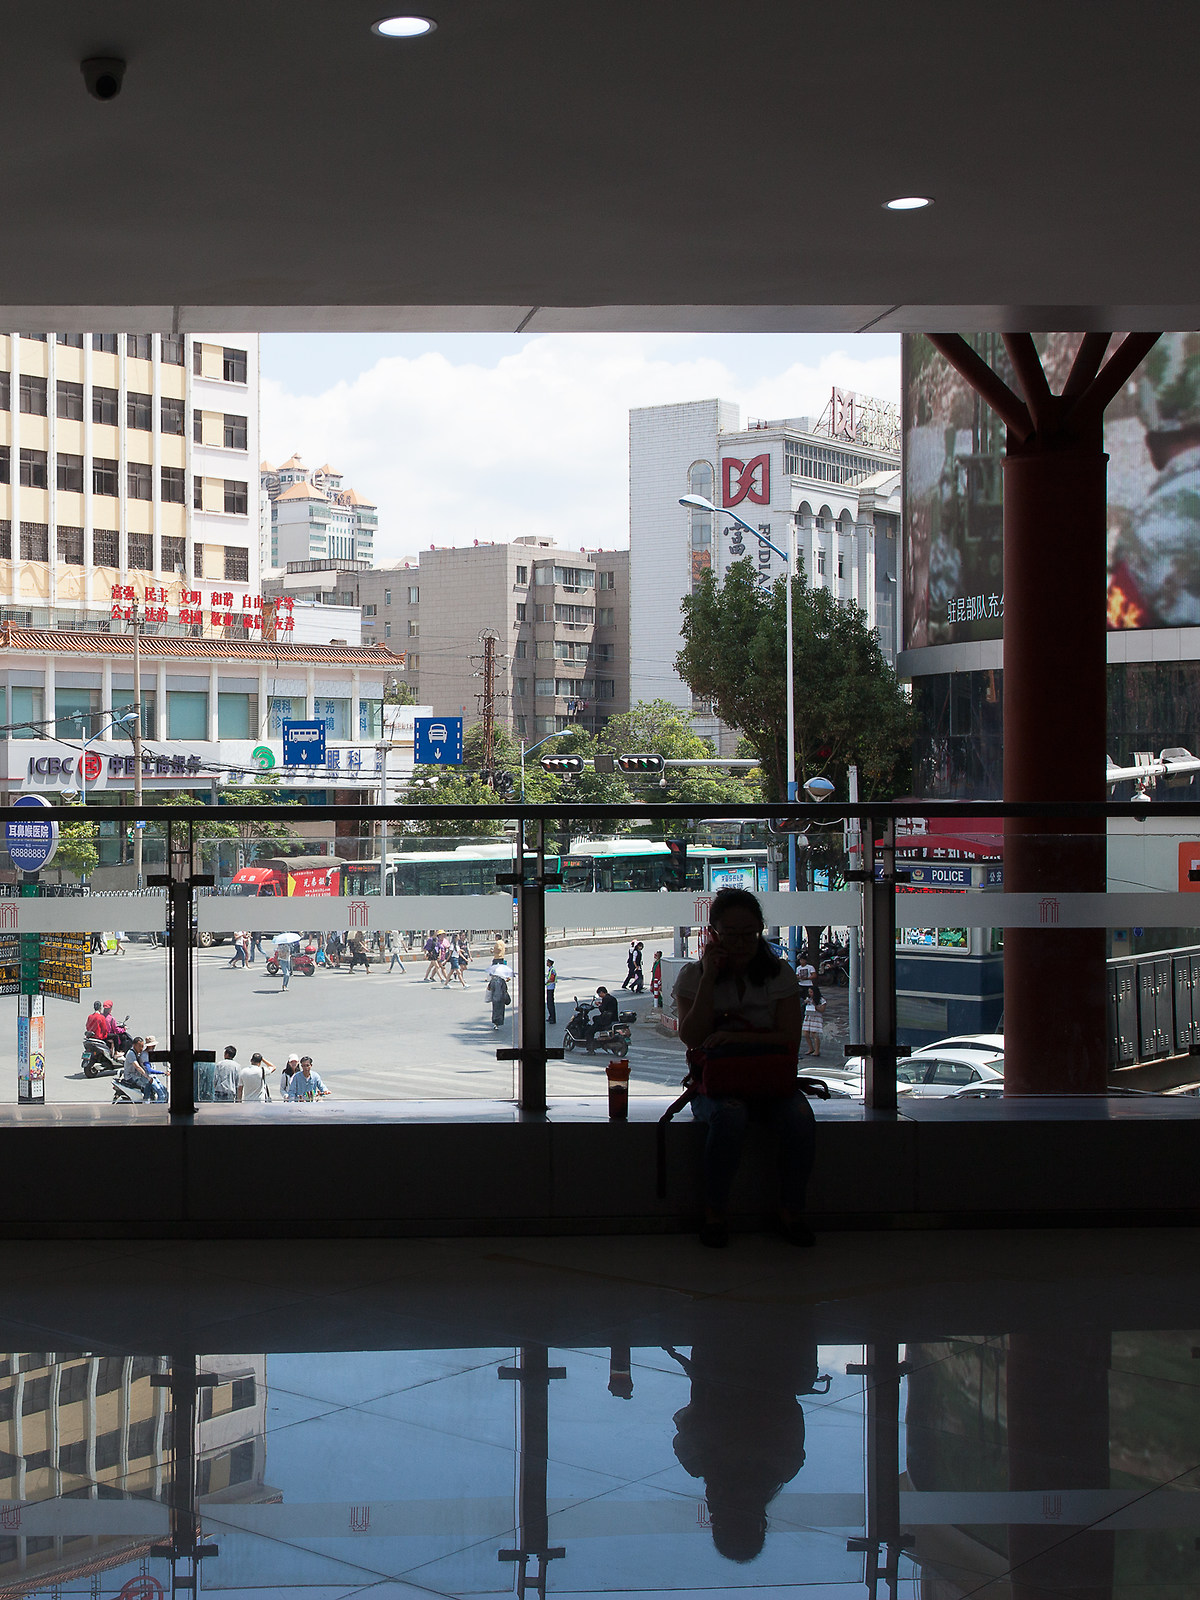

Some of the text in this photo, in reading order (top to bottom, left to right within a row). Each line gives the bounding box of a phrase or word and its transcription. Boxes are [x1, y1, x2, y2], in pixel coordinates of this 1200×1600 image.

[758, 523, 771, 590] FUDIA
[111, 584, 295, 612] 富强 民主 文明 和谐 自由 平等
[111, 604, 295, 631] 公正 法治 爱国 敬业 诚信 友善
[29, 756, 74, 776] ICBC
[8, 824, 49, 838] 耳鼻喉医院
[931, 870, 964, 882] POLICE
